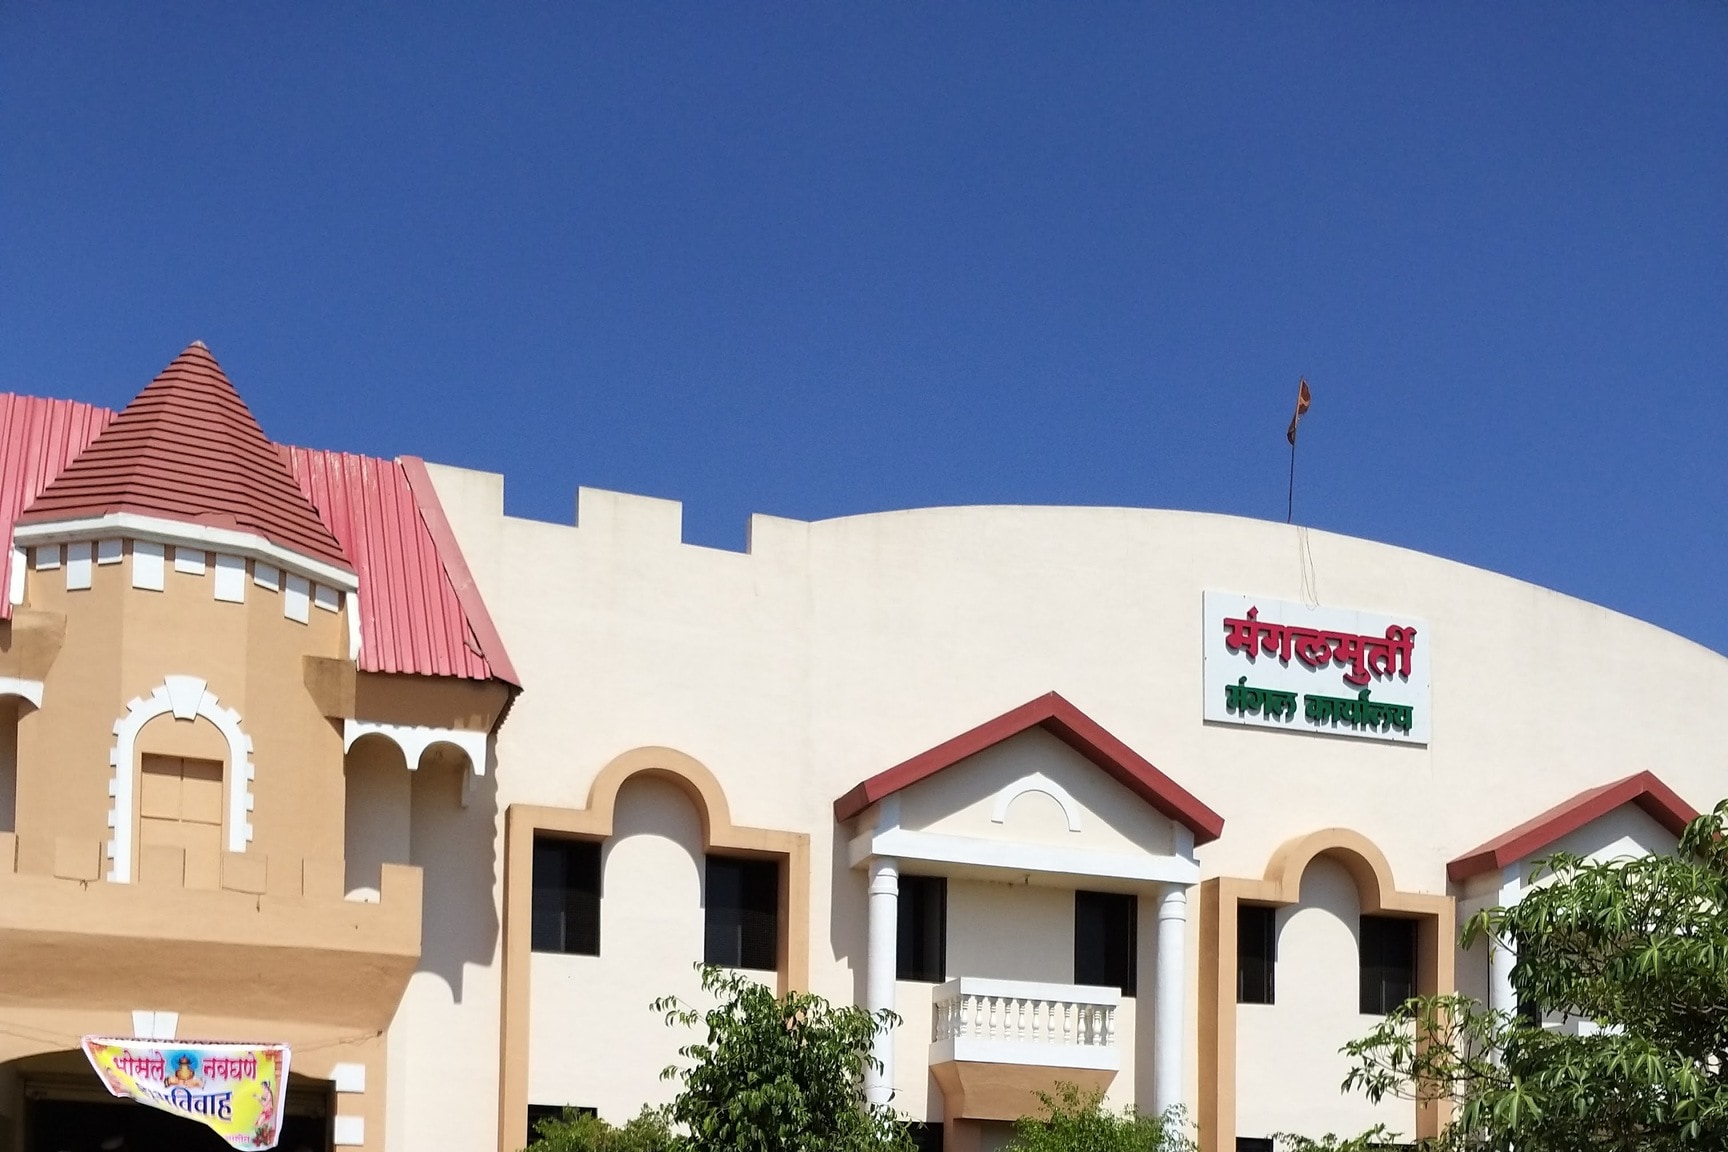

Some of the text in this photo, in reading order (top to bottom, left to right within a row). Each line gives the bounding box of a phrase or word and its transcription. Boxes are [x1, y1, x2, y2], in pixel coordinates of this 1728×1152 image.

[1223, 605, 1417, 685] मंगलमुर्ती
[1225, 676, 1414, 731] मंगल कार्यालय
